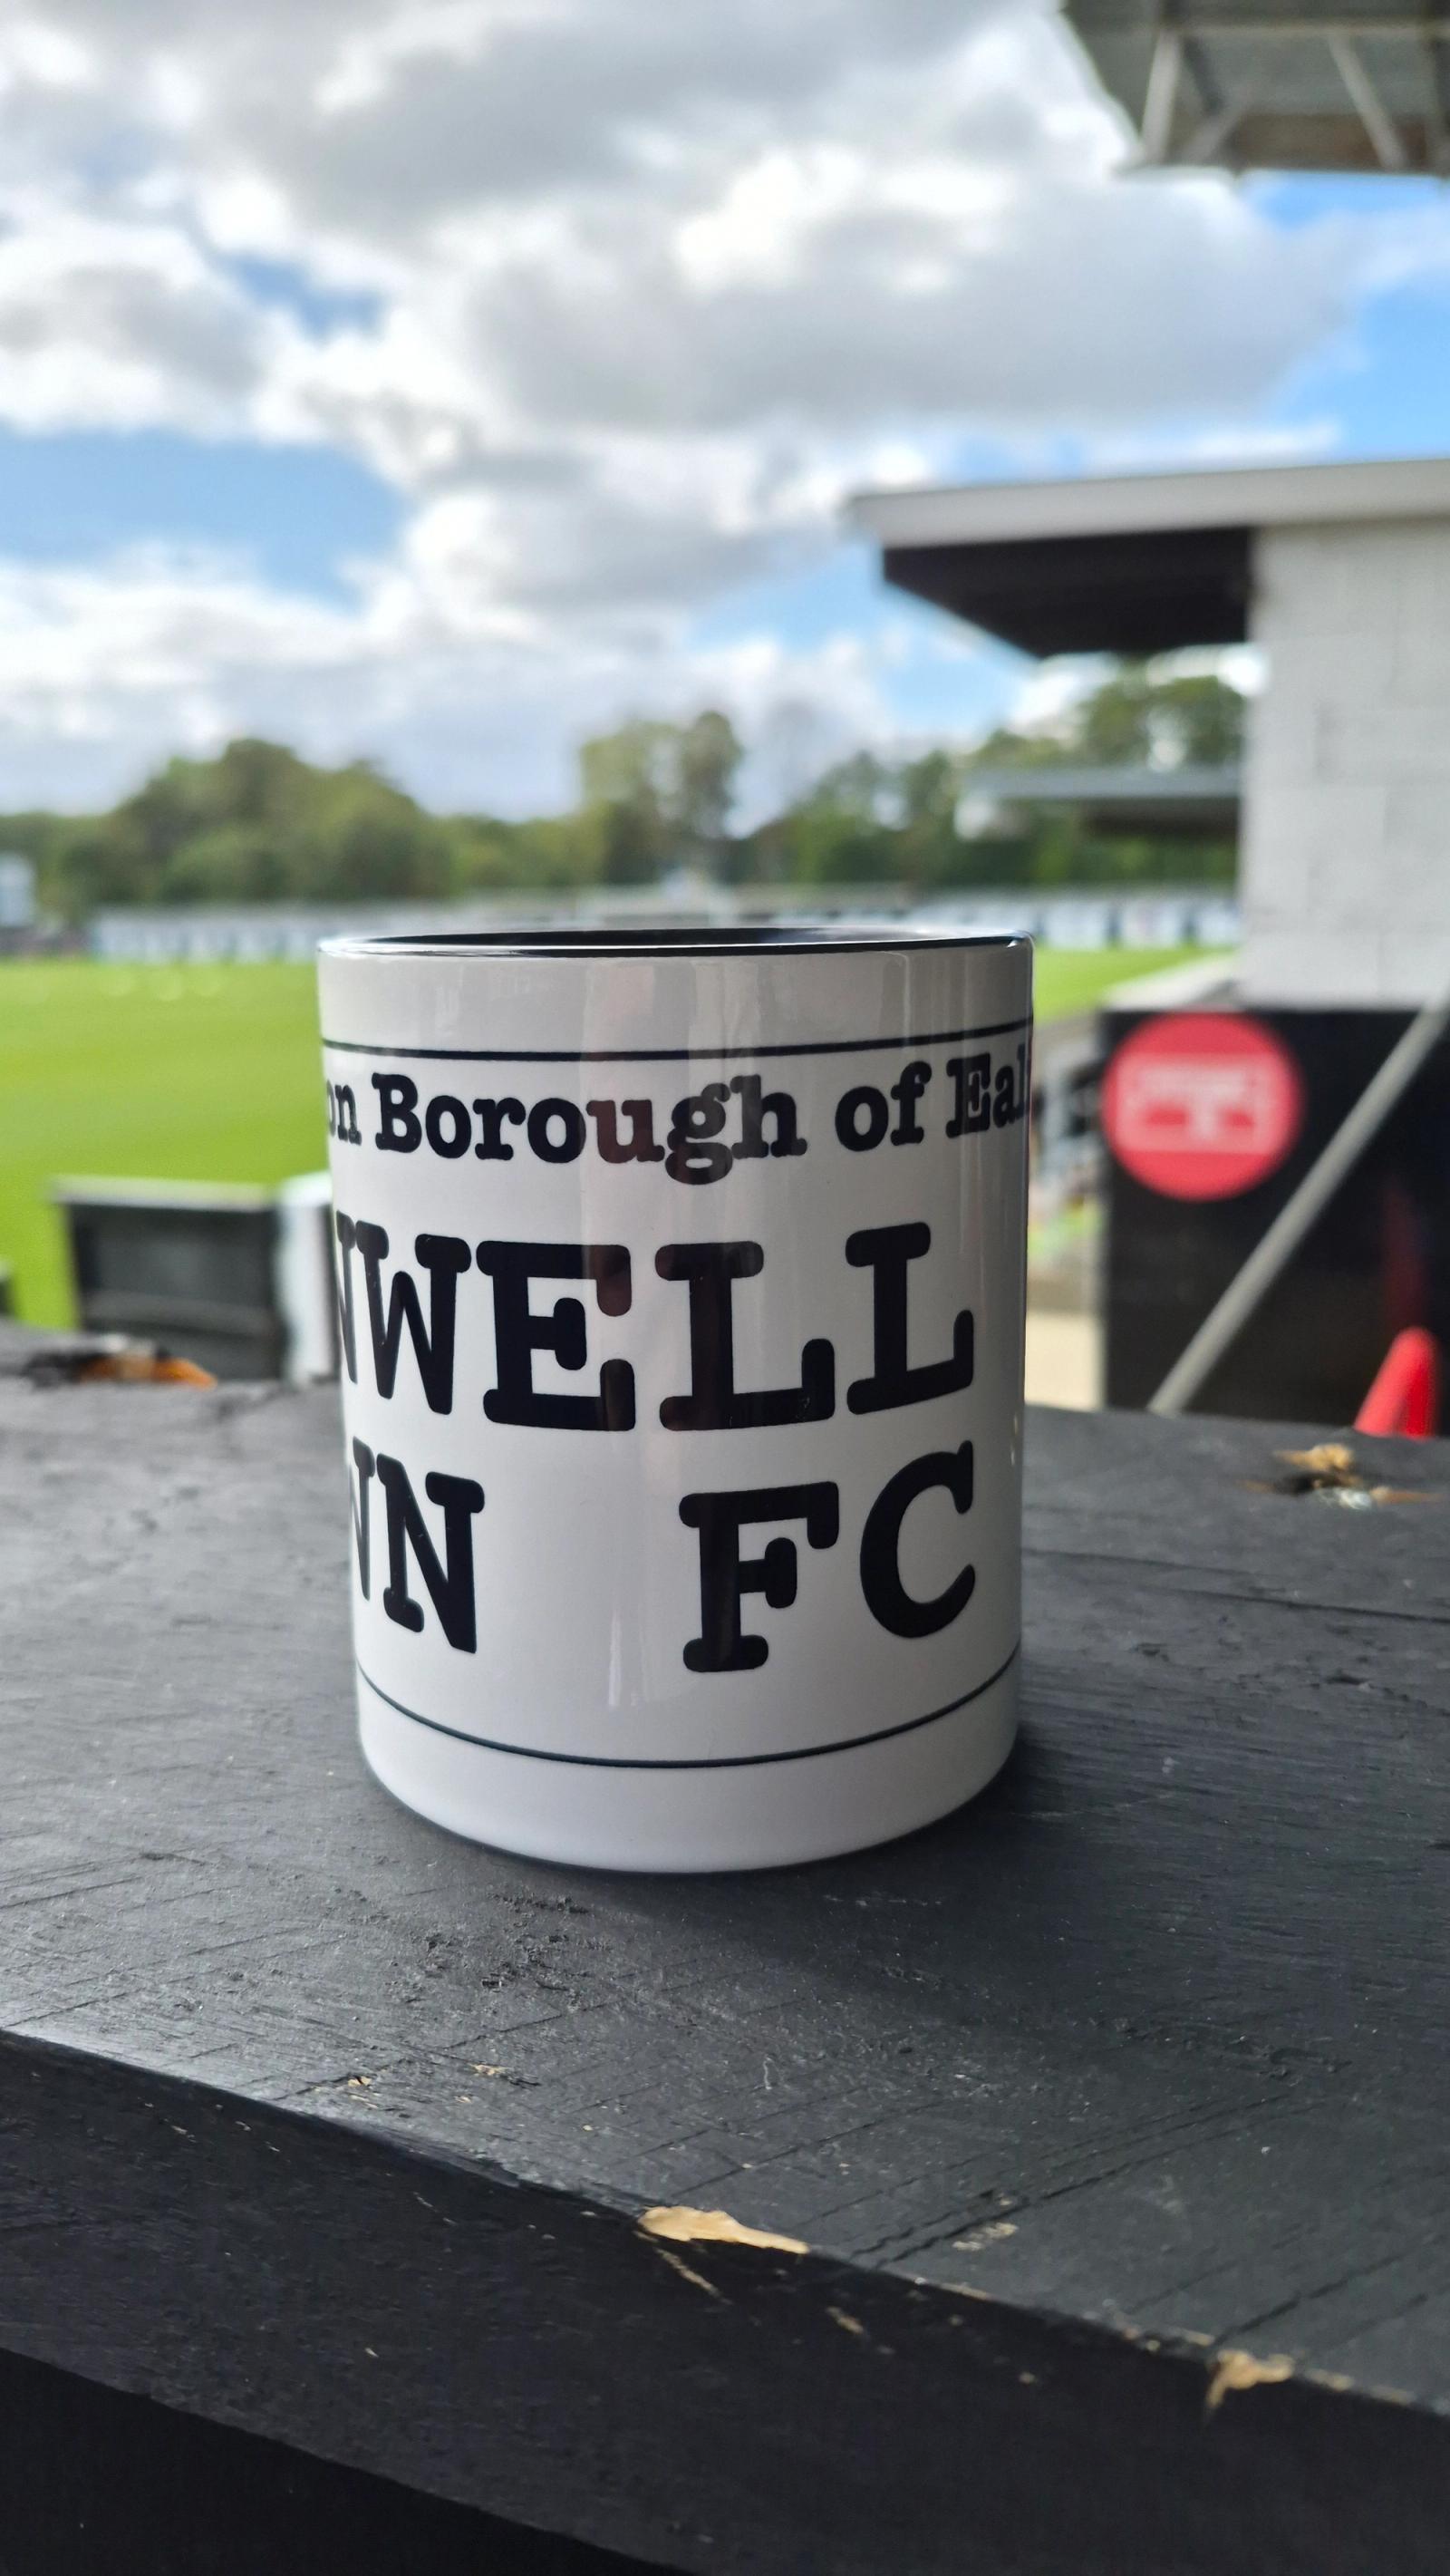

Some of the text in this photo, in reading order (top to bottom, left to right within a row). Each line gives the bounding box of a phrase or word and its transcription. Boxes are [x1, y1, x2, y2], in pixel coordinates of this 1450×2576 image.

[372, 1072, 807, 1185] Borough
[835, 1061, 933, 1152] of
[679, 1440, 976, 1673] FC
